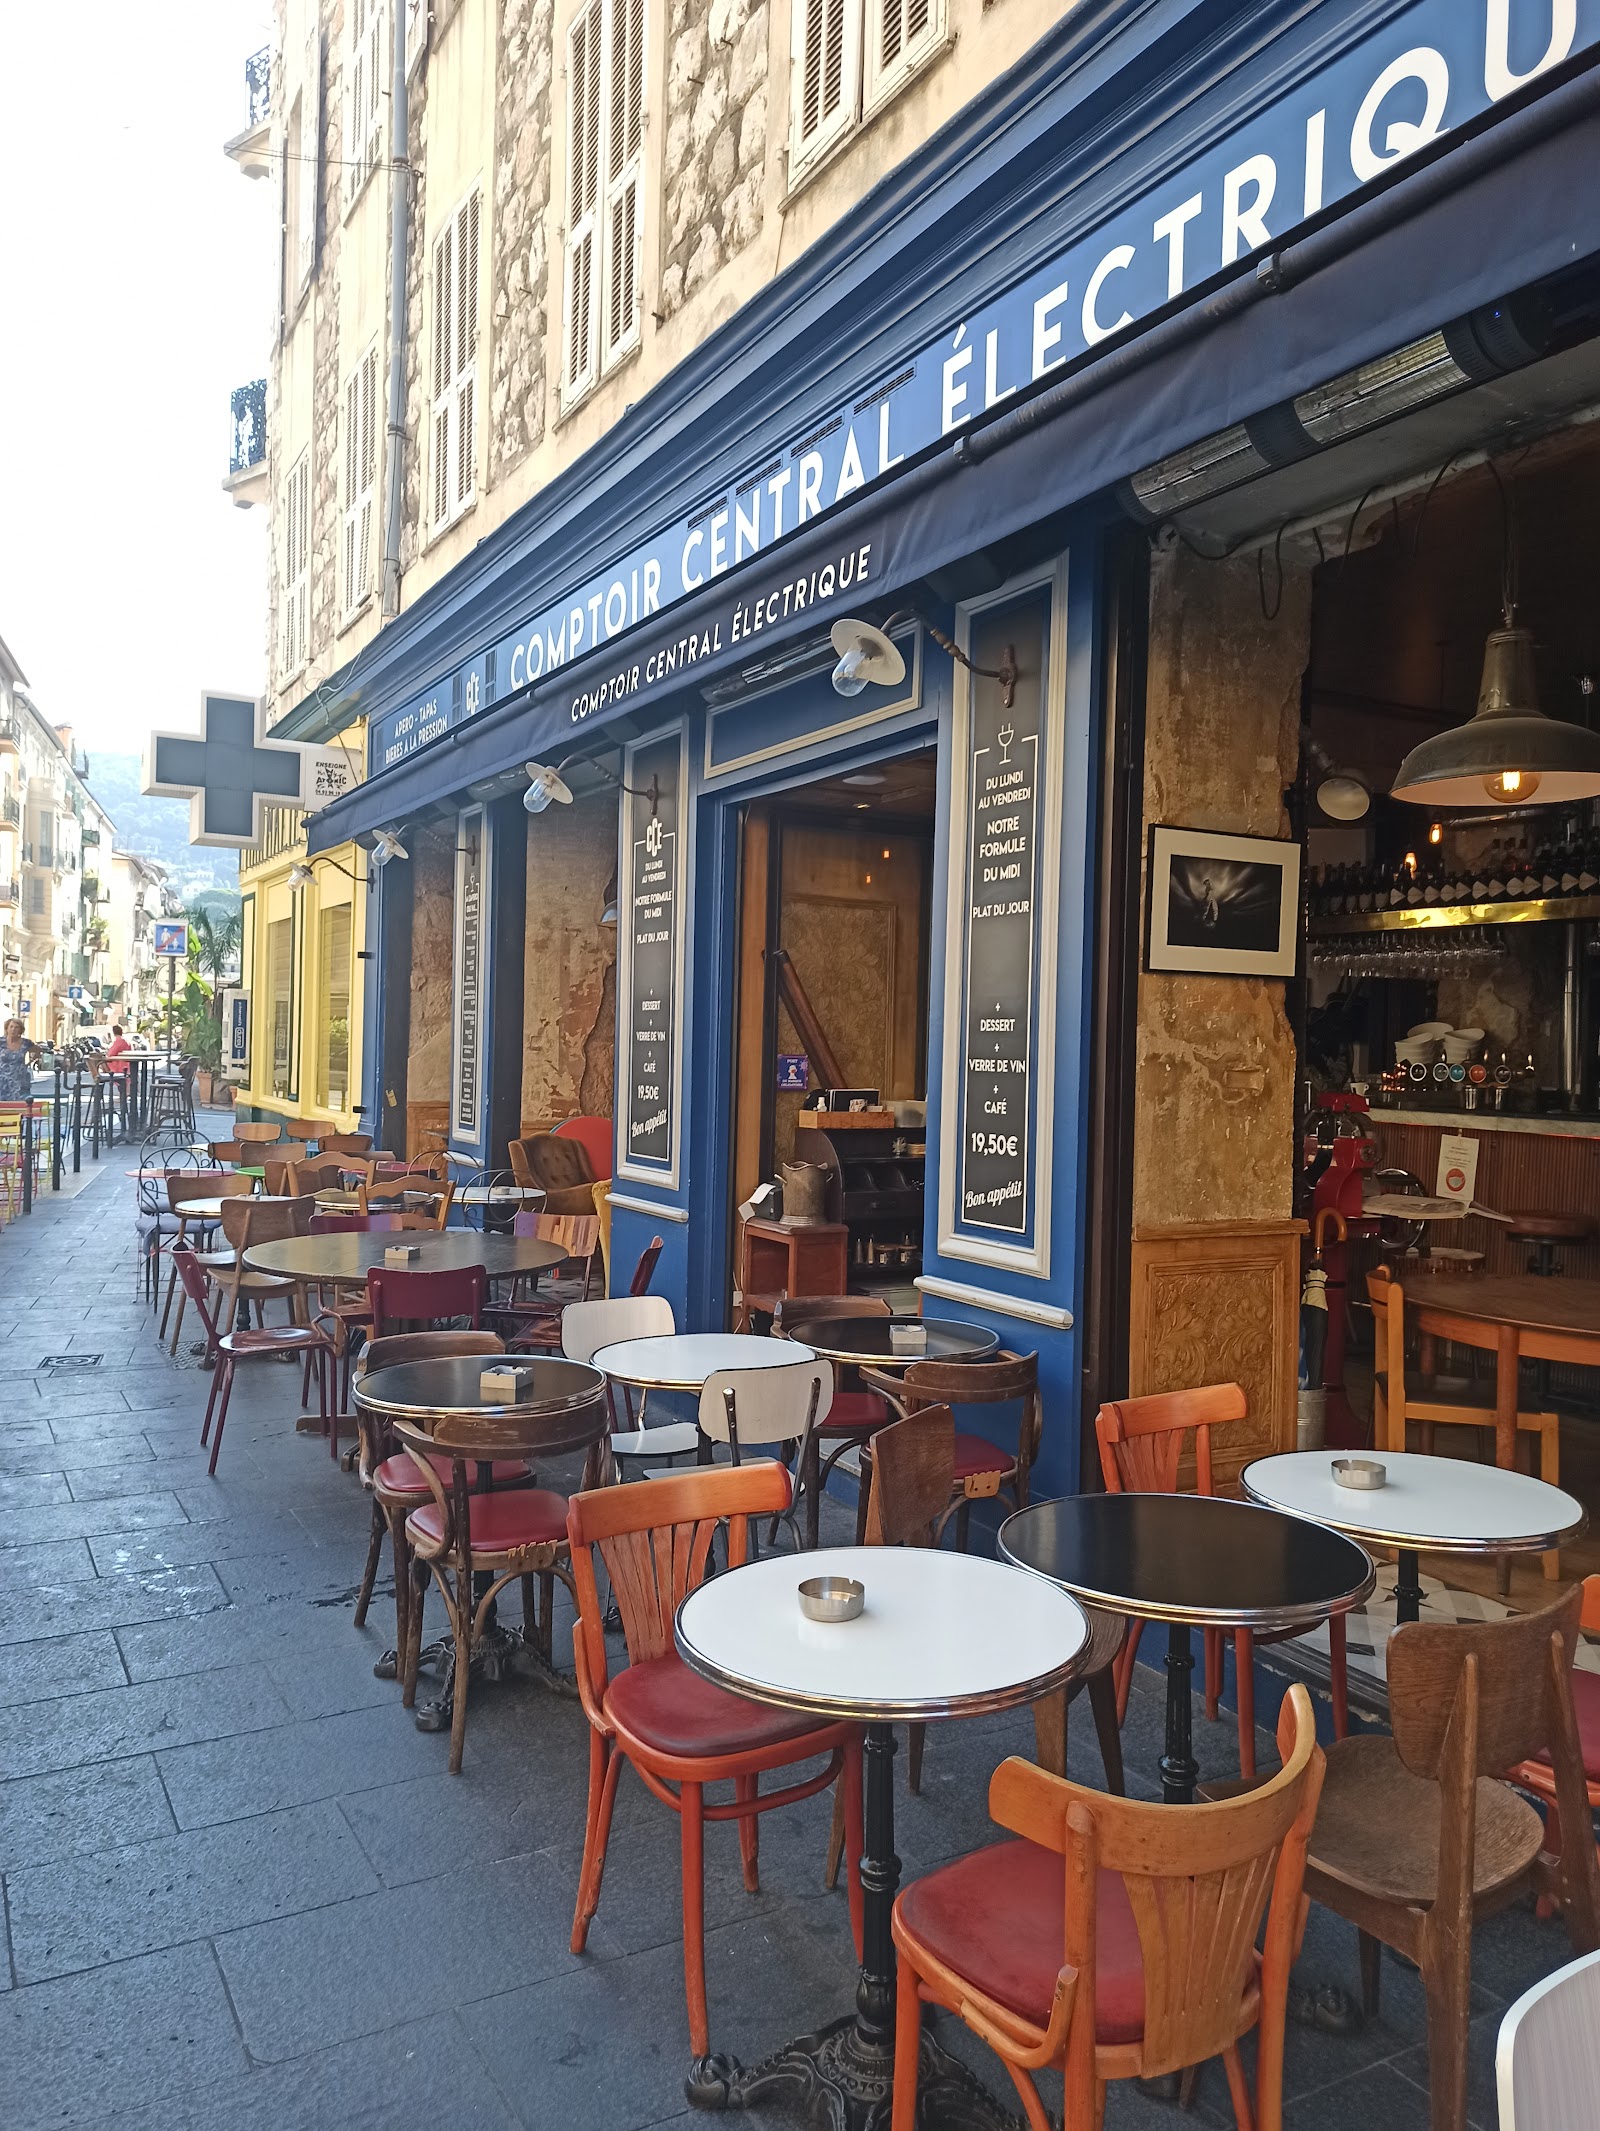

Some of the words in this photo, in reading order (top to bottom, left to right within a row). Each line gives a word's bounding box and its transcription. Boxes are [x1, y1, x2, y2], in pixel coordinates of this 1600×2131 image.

[510, 559, 661, 690] COMPTOIR
[681, 402, 905, 593] CENTRAL
[571, 666, 640, 722] COMPTOIR
[646, 624, 722, 683] CENTRAL
[731, 544, 871, 643] ÉLECTRIQUE
[395, 714, 414, 739] APERO
[419, 698, 437, 723] TAPAS
[385, 740, 403, 764] BIERES
[404, 738, 409, 754] A
[409, 733, 417, 751] LA
[418, 714, 448, 746] PRESSION
[986, 778, 998, 790] DU
[999, 770, 1023, 788] LUNDI
[978, 796, 990, 810] AU
[992, 787, 1031, 806] VENDREDI
[987, 816, 1019, 836] NOTRE
[980, 836, 1026, 859] FORMULE
[645, 862, 651, 871] DU
[984, 867, 998, 882] DU
[1000, 862, 1020, 880] MIDI
[635, 894, 650, 906] NOTRE
[650, 890, 672, 903] FORMULE
[644, 909, 651, 919] DU
[651, 906, 662, 917] MIDI
[972, 903, 992, 919] PLAT
[993, 902, 1005, 916] DU
[1006, 900, 1029, 915] JOUR
[637, 933, 648, 944] PLAT
[648, 932, 655, 943] DU
[656, 930, 669, 942] JOUR
[641, 1000, 661, 1011] DESSERT
[980, 1018, 1015, 1032] DESSERT
[636, 1031, 650, 1041] VERRE
[650, 1031, 657, 1041] DE
[657, 1031, 666, 1041] VIN
[643, 1060, 656, 1073] CAFÉ
[969, 1058, 996, 1072] VERRE
[997, 1060, 1009, 1072] DE
[1010, 1059, 1026, 1073] VIN
[637, 1084, 660, 1101] 19,50€
[984, 1098, 1007, 1115] CAFÉ
[631, 1120, 645, 1138] Bon
[644, 1108, 668, 1136] appétit
[971, 1132, 1018, 1157] 19,50€
[965, 1189, 986, 1208] Bon
[987, 1180, 1023, 1207] appétit
